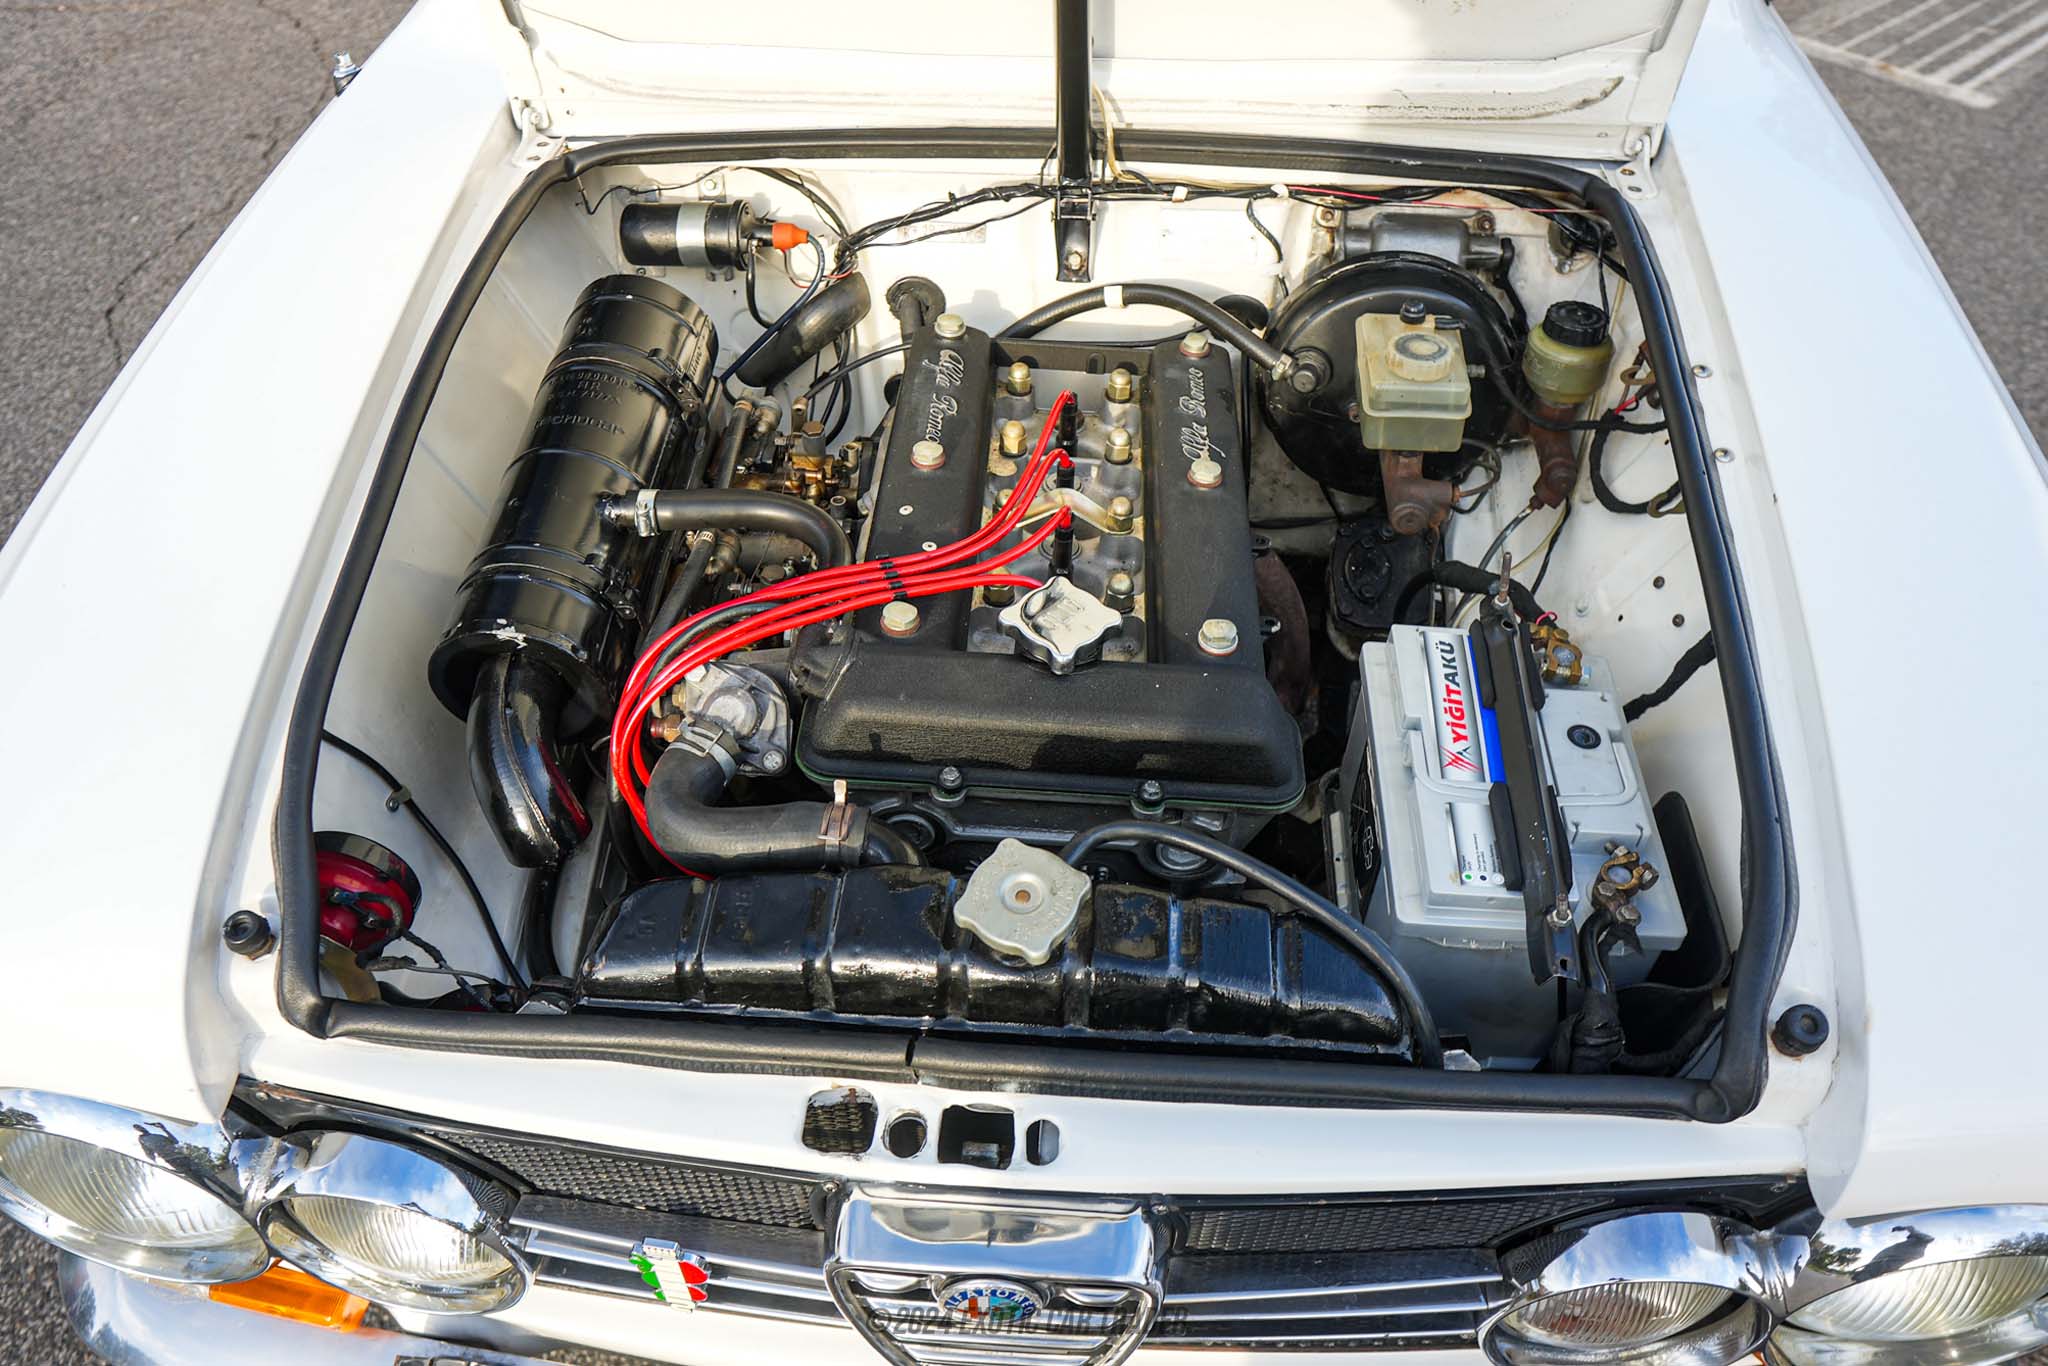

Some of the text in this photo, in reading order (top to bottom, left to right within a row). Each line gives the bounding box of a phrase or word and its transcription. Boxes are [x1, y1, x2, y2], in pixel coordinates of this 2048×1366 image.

[922, 349, 965, 444] Alfa Romeo
[1178, 367, 1226, 461] Alfa Romeo
